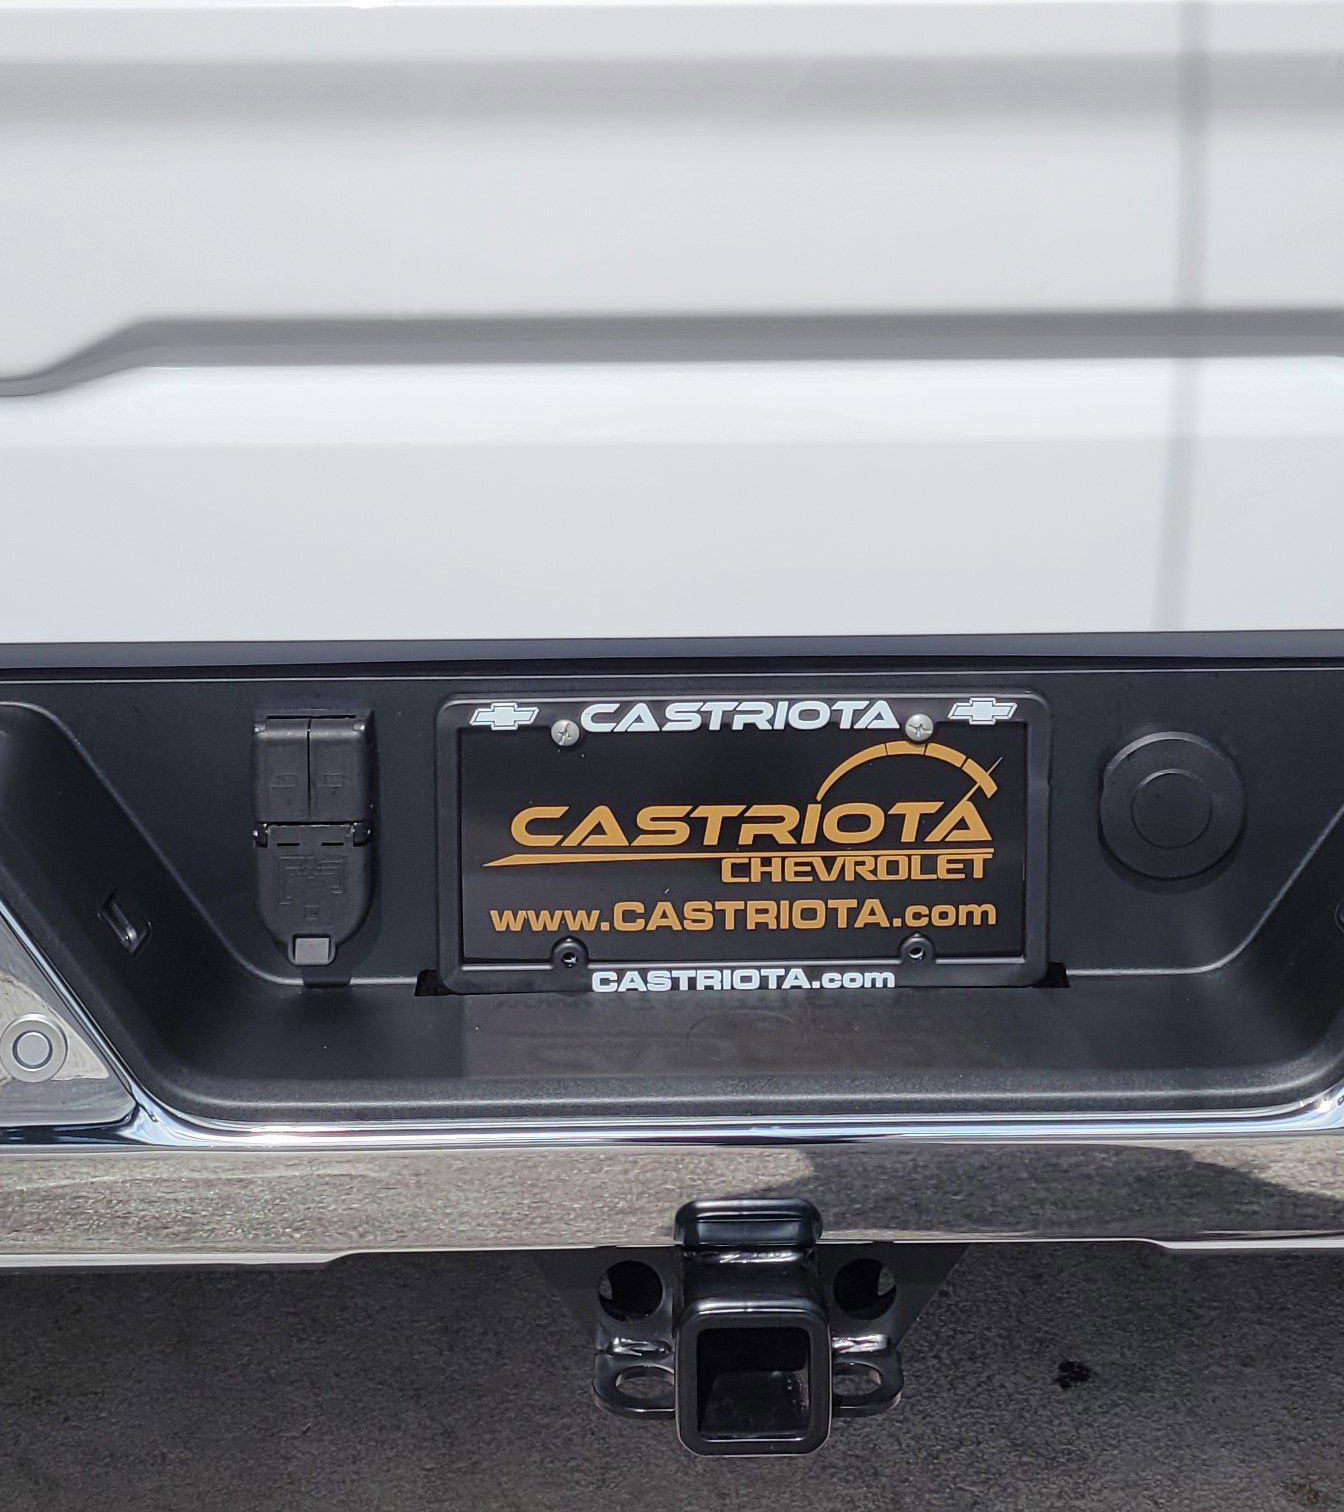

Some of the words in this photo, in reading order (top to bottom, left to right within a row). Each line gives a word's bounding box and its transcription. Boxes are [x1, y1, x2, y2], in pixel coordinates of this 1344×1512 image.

[580, 700, 900, 732] CASTRIOTA
[510, 800, 993, 846] CASTRIOTA
[721, 855, 993, 884] CHEVROLET
[490, 898, 998, 934] www.CASTRIOTA.com
[591, 968, 897, 993] CASTRIOTA.com
